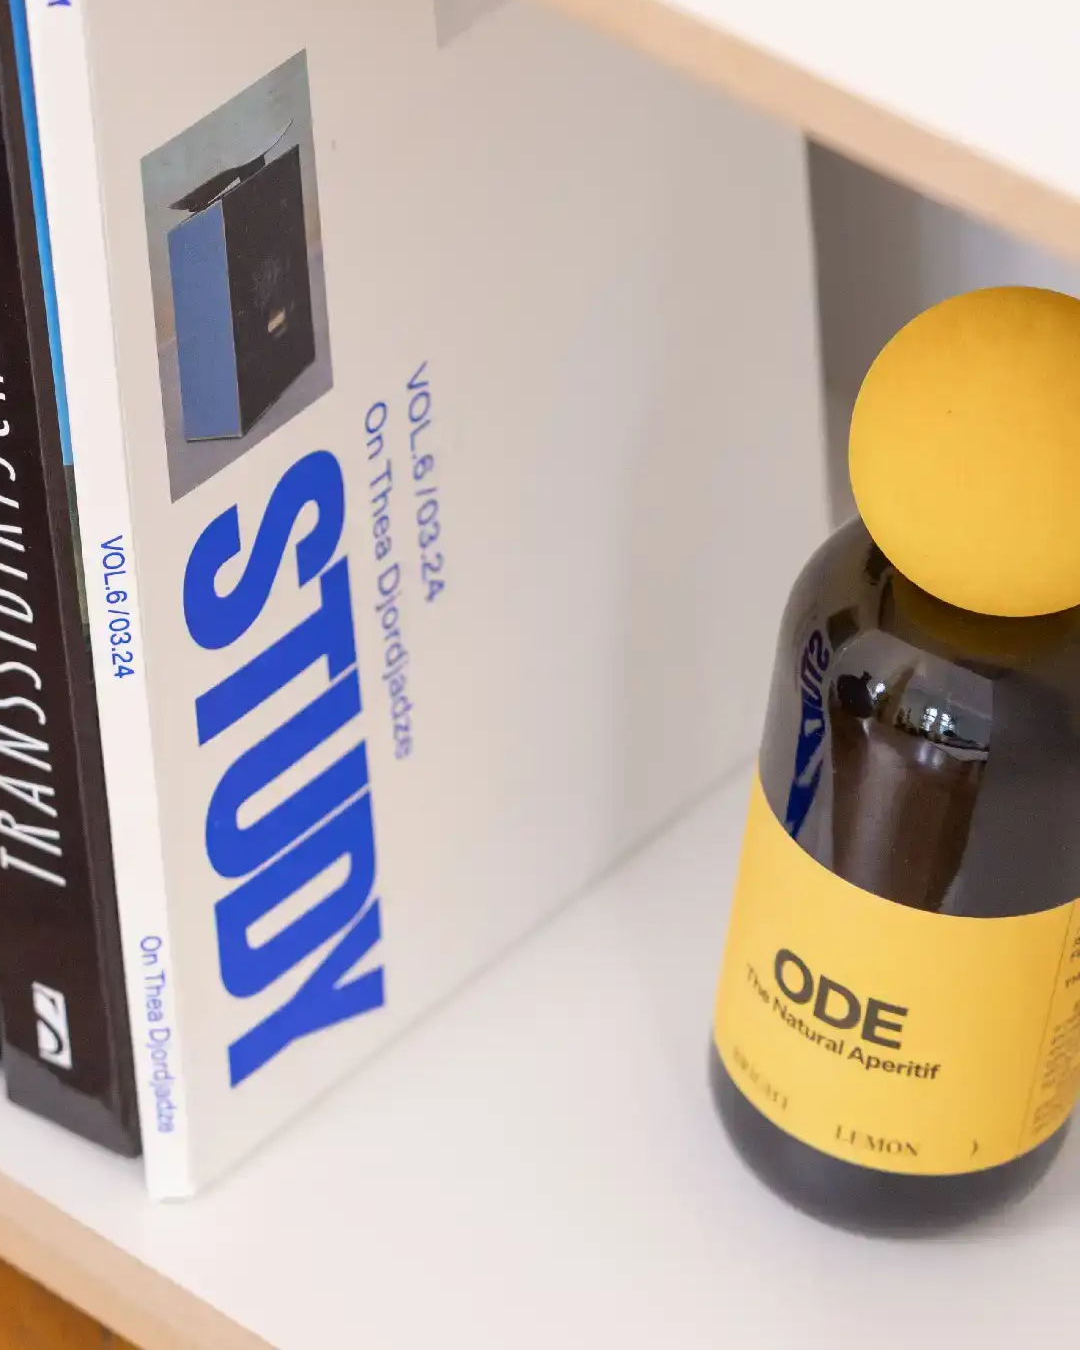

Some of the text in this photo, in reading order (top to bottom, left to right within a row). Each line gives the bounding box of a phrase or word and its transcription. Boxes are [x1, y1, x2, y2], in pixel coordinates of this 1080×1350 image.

[365, 401, 414, 760] On Thea Djordjadze
[182, 449, 386, 1089] STUDY
[140, 935, 178, 1133] On Thea Djordjadze
[746, 963, 942, 1081] The Natural Aperitif
[774, 948, 909, 1050] ODE
